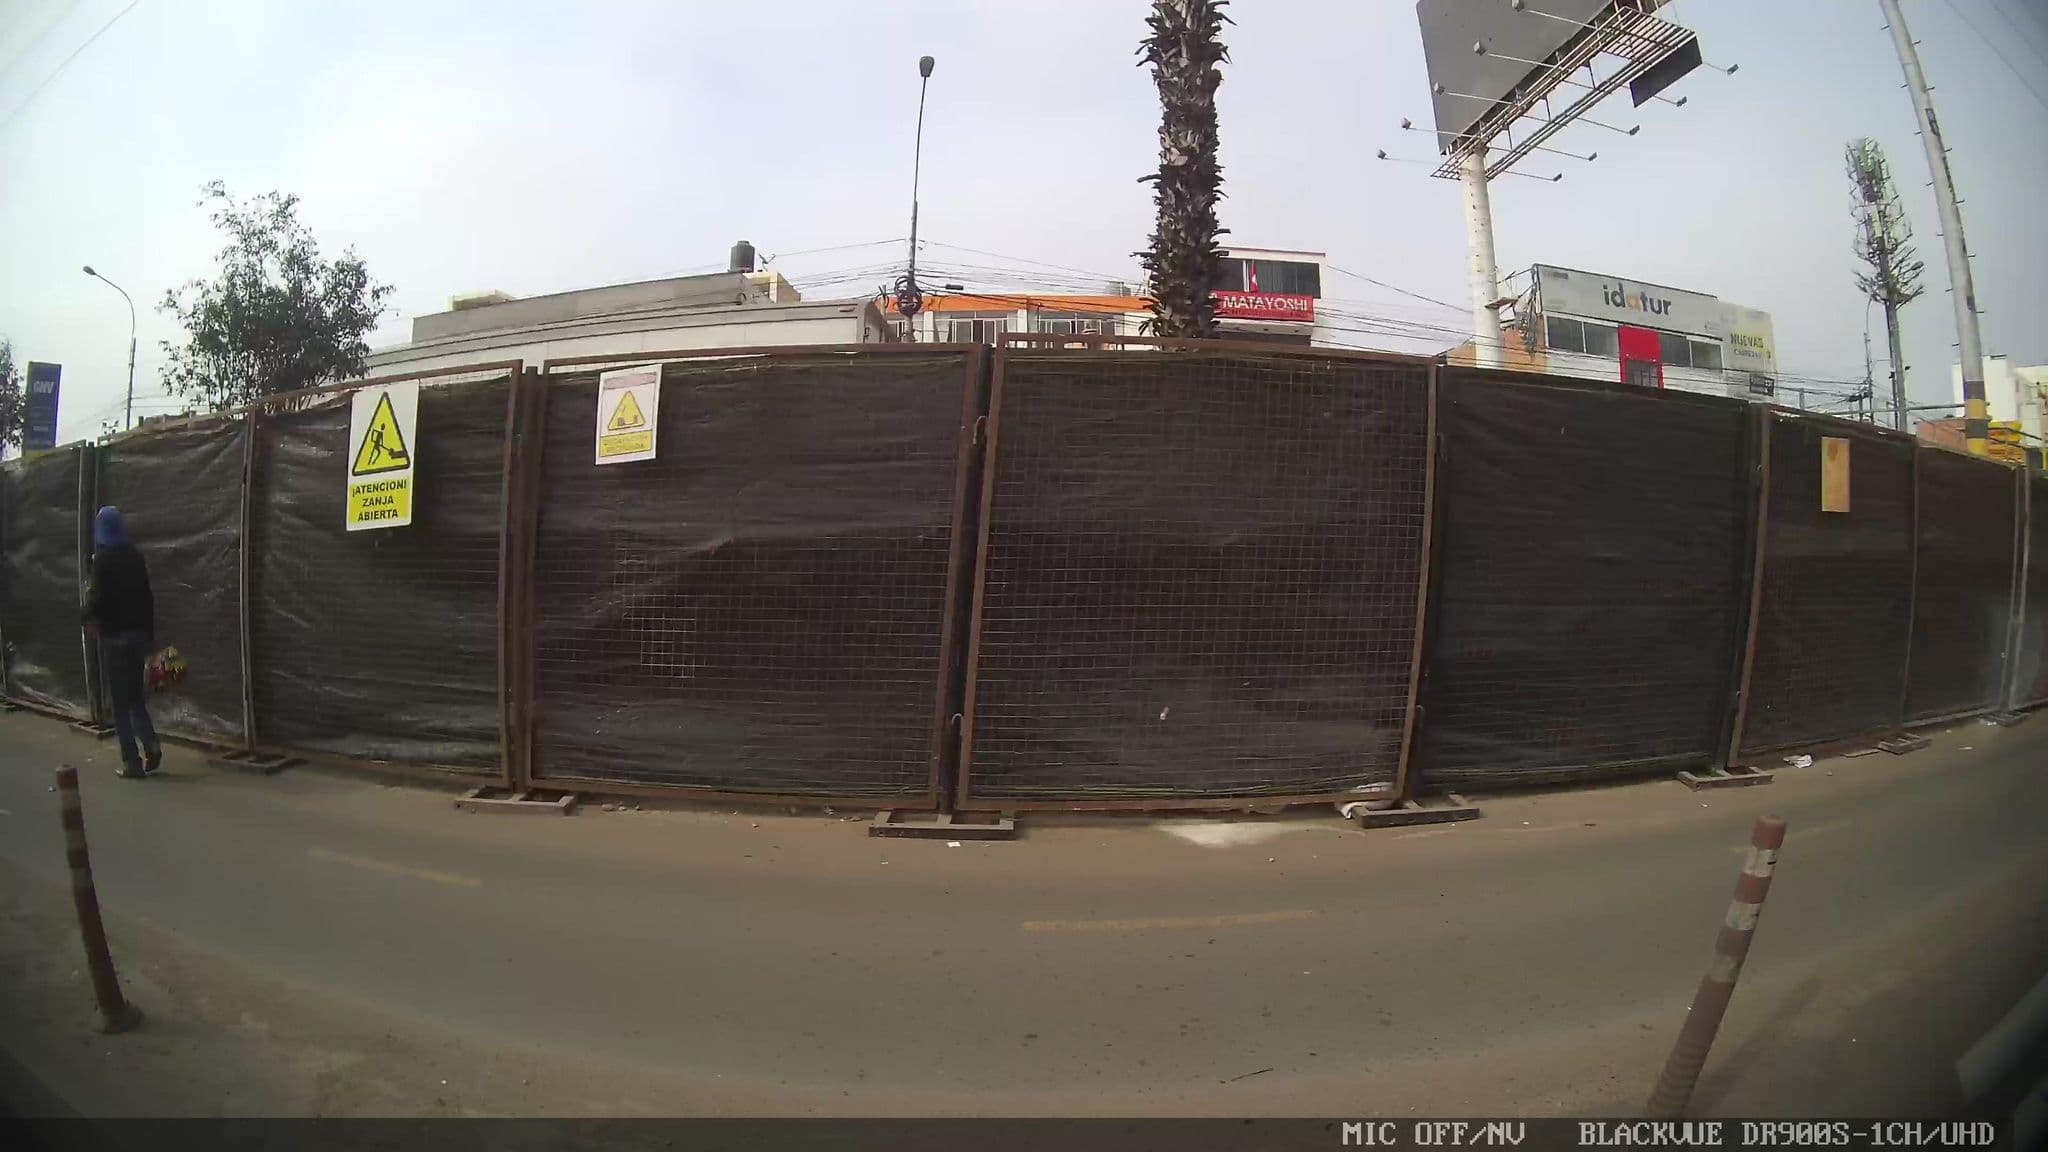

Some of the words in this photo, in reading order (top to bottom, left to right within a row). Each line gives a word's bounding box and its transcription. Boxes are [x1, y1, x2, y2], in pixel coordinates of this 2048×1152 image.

[1223, 295, 1308, 311] MATAYOSHI
[1603, 283, 1671, 315] idatur
[362, 496, 394, 507] ZANJA
[357, 509, 398, 521] ABIERTA
